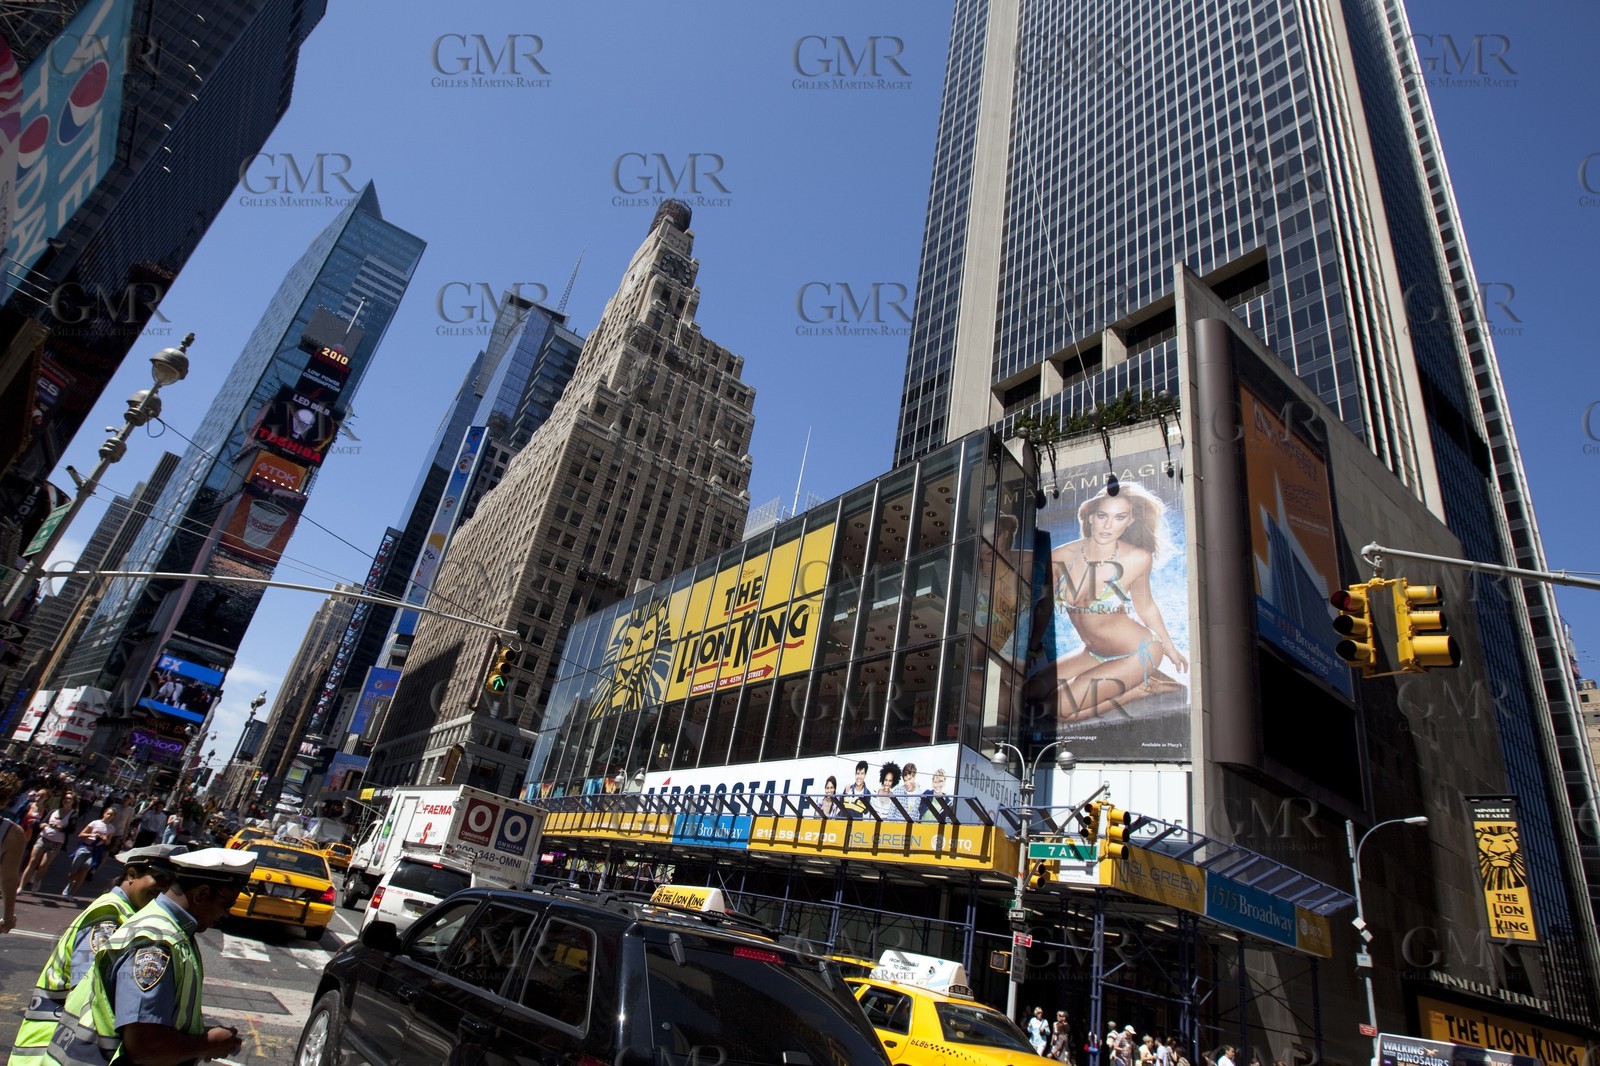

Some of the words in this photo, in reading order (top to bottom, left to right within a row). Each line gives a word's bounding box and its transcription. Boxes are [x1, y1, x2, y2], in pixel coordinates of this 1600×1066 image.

[321, 347, 350, 366] 2010
[292, 394, 311, 407] LED
[259, 427, 322, 463] TOSHIBA
[268, 465, 298, 484] TDK
[1043, 459, 1178, 496] RAMPAGE
[724, 575, 763, 612] THE
[676, 630, 734, 684] LION
[733, 604, 810, 669] KING
[1295, 628, 1334, 671] Broadway
[159, 656, 183, 672] FX
[719, 677, 729, 687] ON
[133, 731, 182, 753] YAHOO!
[423, 804, 452, 815] FAEMA
[698, 821, 743, 839] Broadway
[757, 828, 837, 843] 212.594.2700
[871, 833, 921, 848] GREEN
[1048, 846, 1056, 857] 7
[1150, 867, 1200, 893] GREEN
[662, 893, 674, 903] THE
[671, 892, 688, 906] LION
[686, 893, 705, 908] KING
[1495, 892, 1518, 903] THE
[1211, 885, 1239, 912] 1515
[1239, 893, 1294, 938] Broadway
[1493, 902, 1525, 918] LION
[1495, 918, 1529, 935] KING
[1383, 1041, 1425, 1056] WALKING
[1446, 1014, 1481, 1044] THE
[1483, 1015, 1530, 1056] LION
[1531, 1027, 1579, 1066] KING
[1396, 1051, 1450, 1066] DINOSAURS
